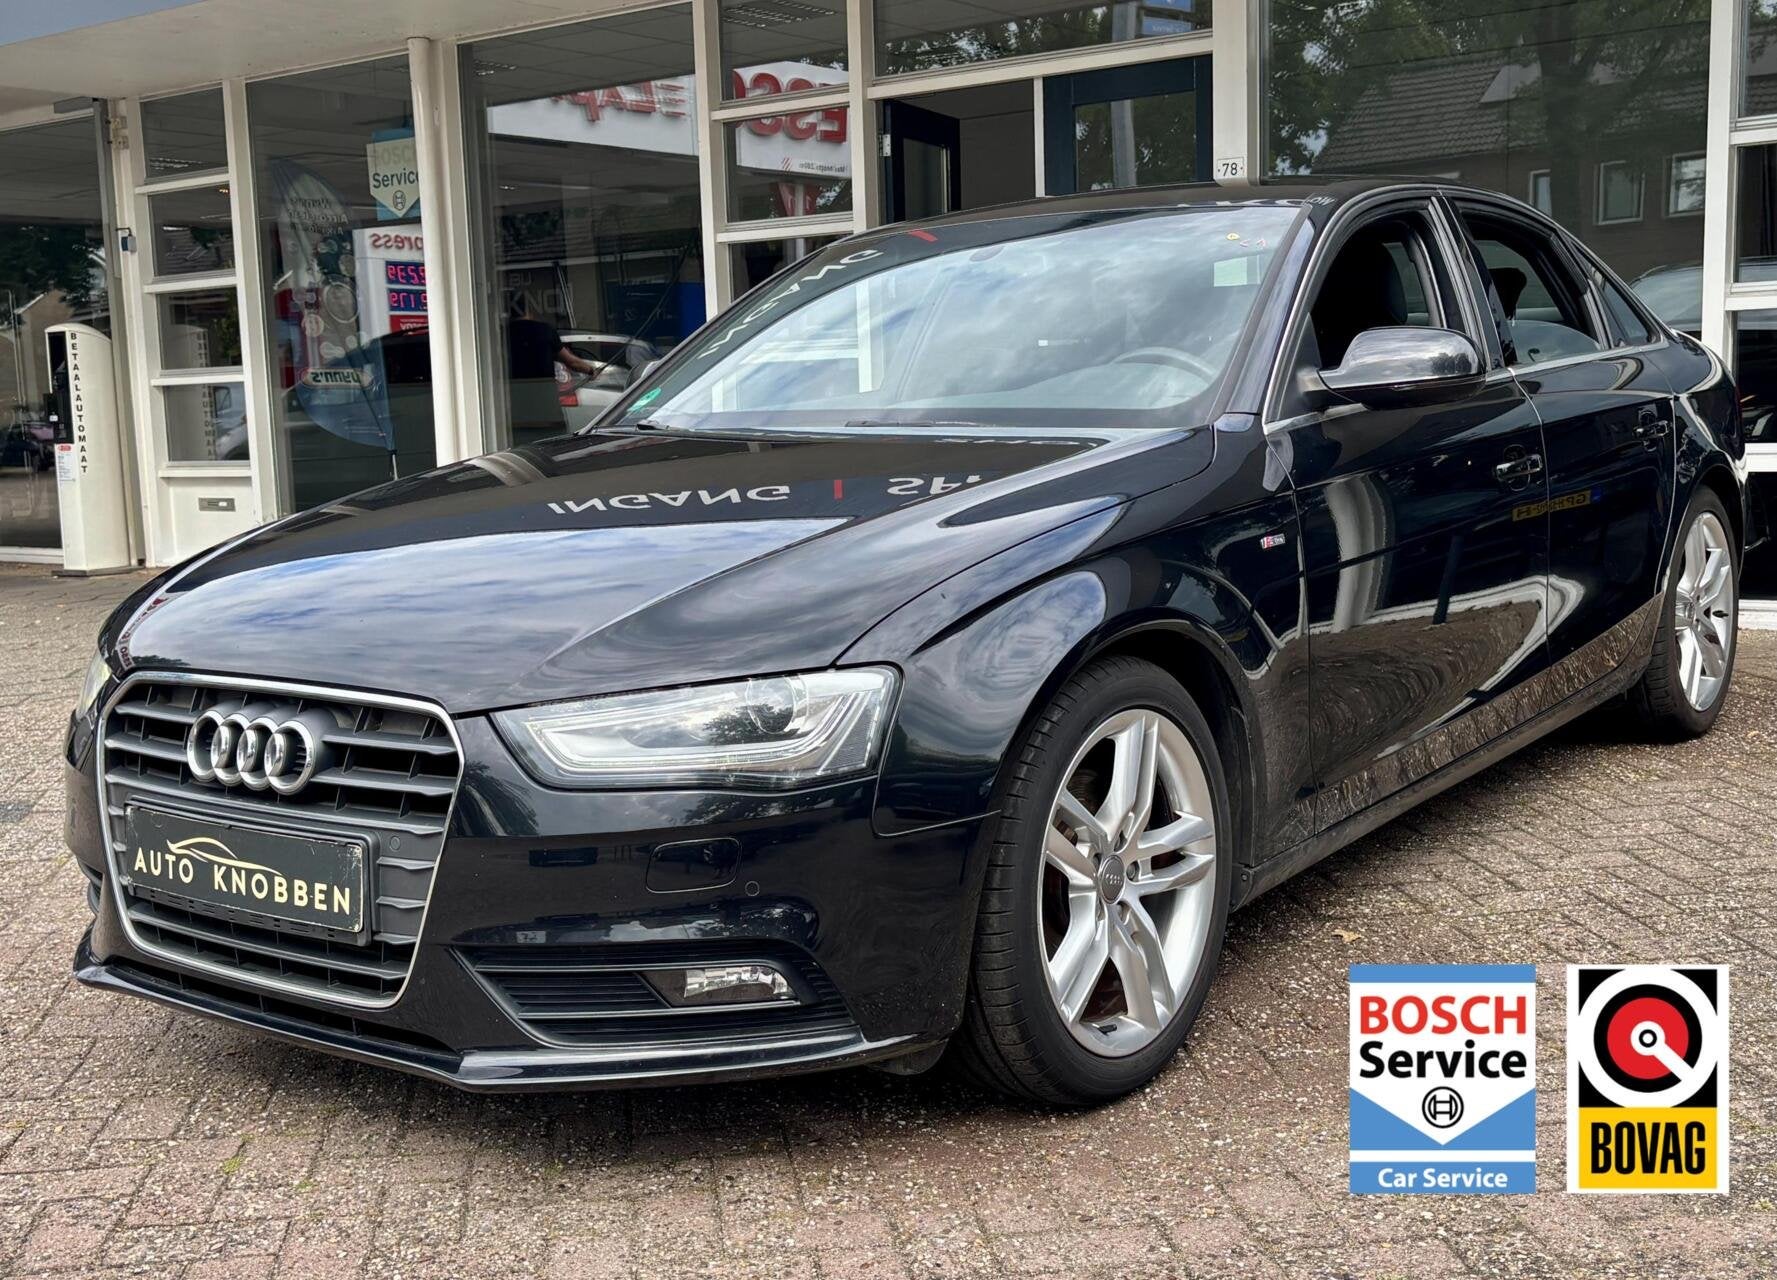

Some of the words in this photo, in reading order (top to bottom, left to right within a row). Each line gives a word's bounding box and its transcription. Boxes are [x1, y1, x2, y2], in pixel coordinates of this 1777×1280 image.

[372, 168, 419, 189] Servic
[1221, 162, 1238, 177] 78
[70, 332, 88, 473] BETAALAUTOMAAT
[134, 847, 194, 884] AUTO
[213, 864, 350, 915] KNOBBEN
